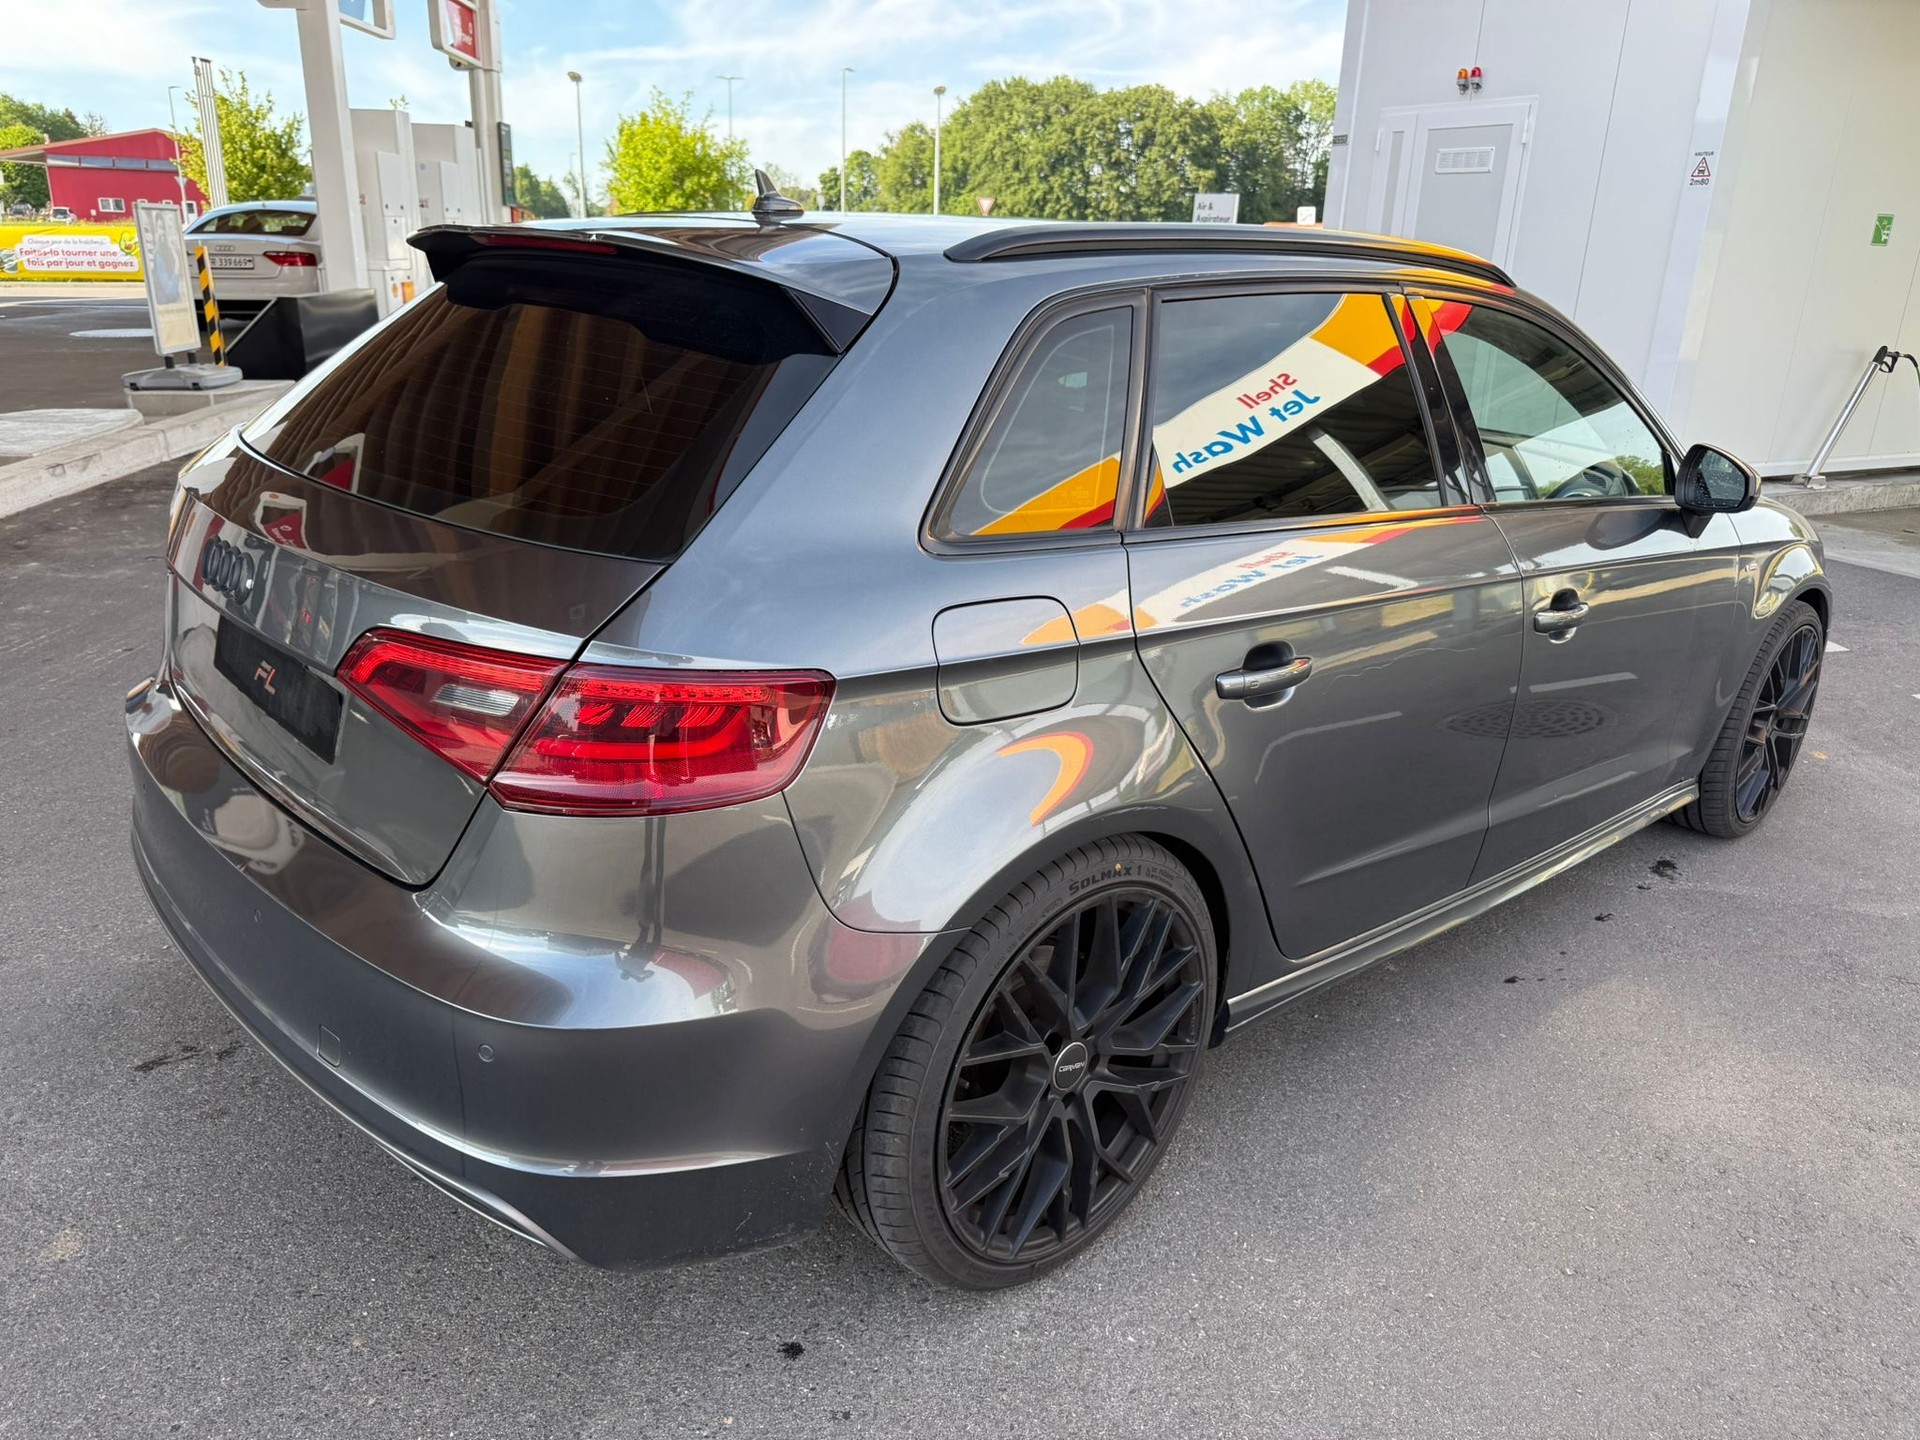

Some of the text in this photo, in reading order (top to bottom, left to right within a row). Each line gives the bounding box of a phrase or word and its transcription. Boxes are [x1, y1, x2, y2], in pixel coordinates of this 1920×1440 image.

[1689, 178, 1710, 186] 2m80
[1197, 202, 1207, 210] Air
[61, 249, 97, 257] tourner
[27, 258, 135, 269] fois par jour et gagnez
[1068, 866, 1133, 896] SOLMAX
